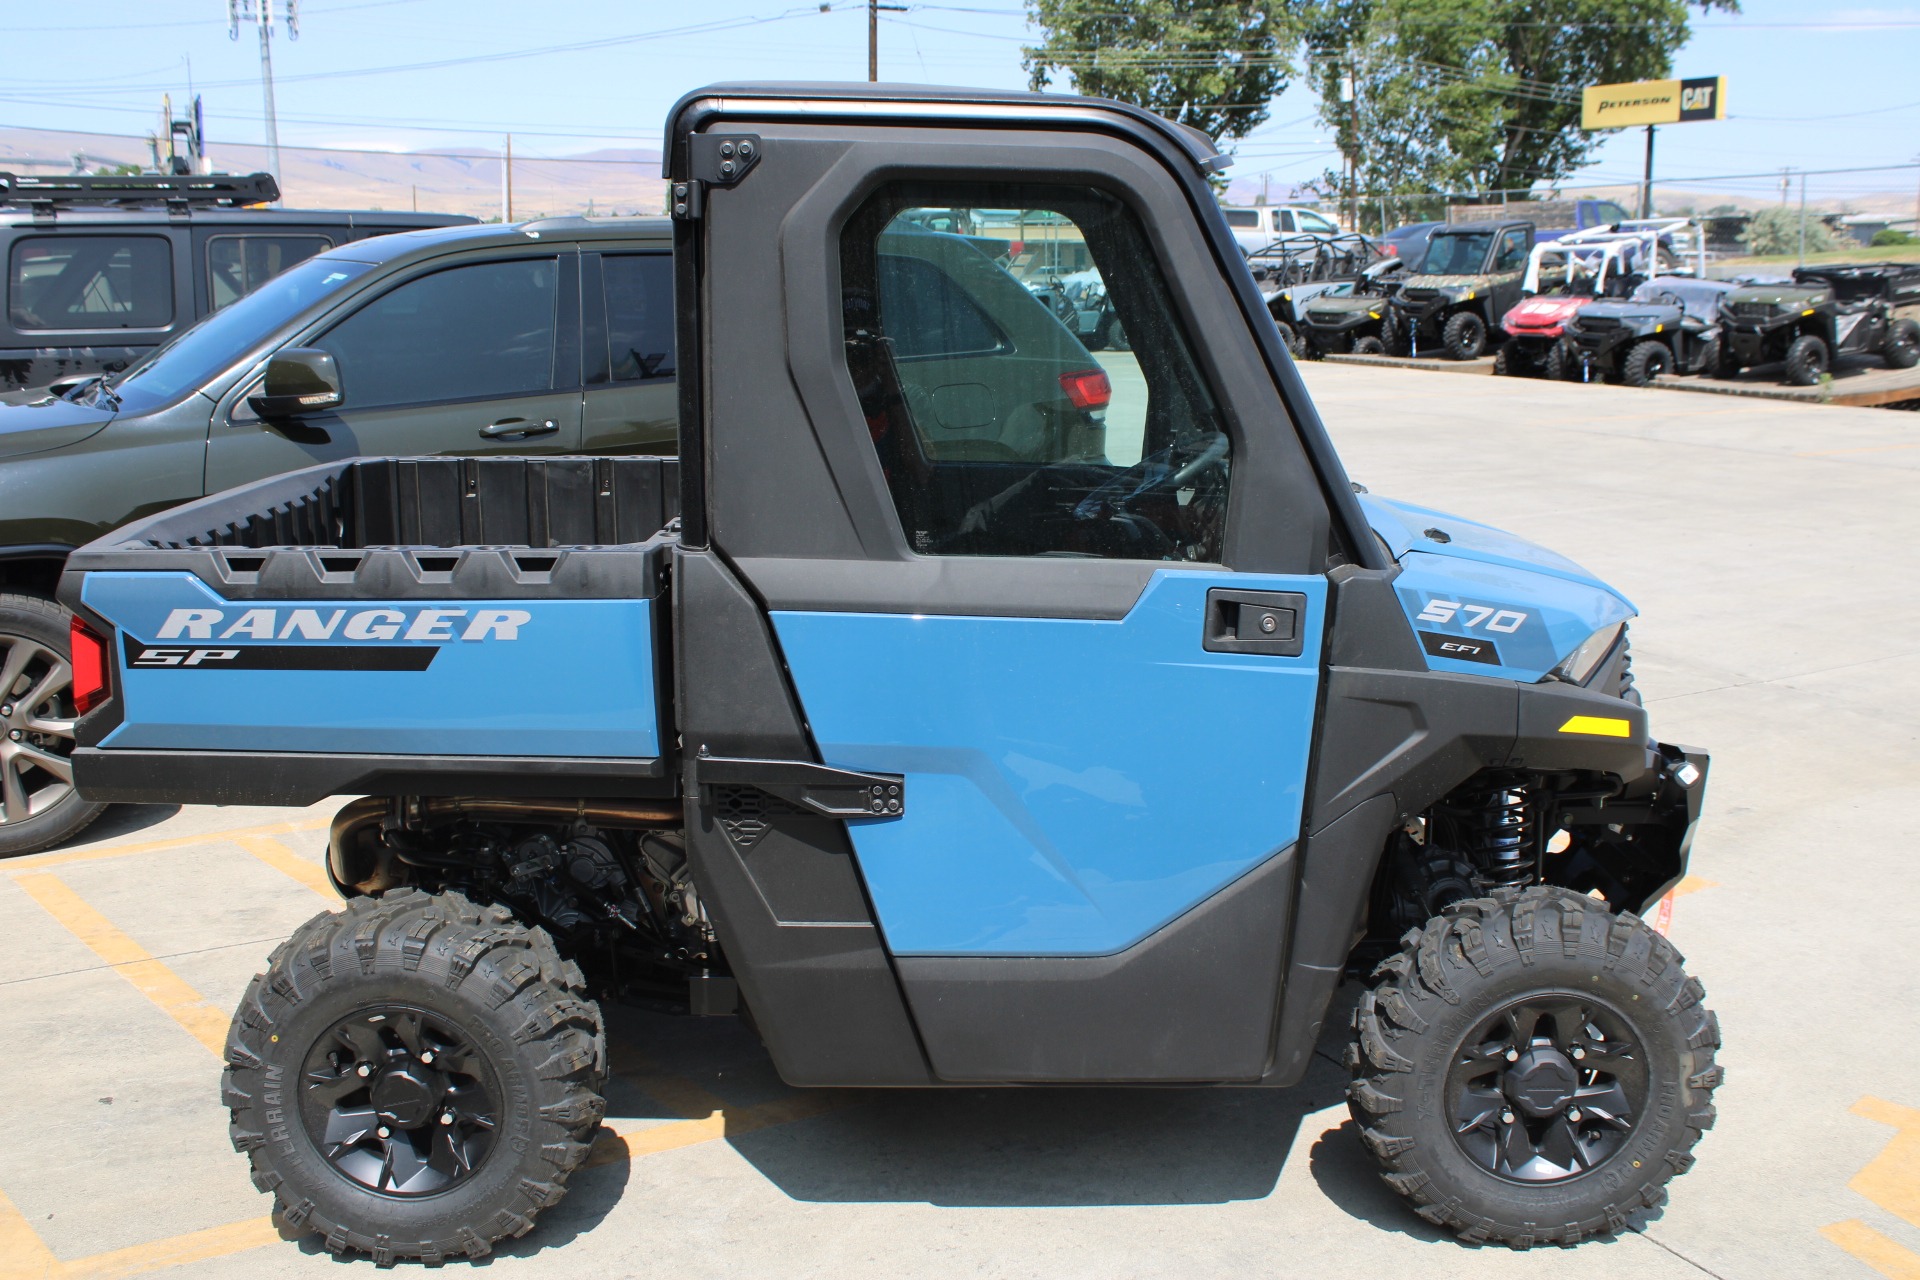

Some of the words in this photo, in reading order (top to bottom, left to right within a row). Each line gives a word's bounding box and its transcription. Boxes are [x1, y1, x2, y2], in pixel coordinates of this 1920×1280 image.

[1597, 95, 1672, 114] PETERSON
[1682, 86, 1714, 111] CAT
[156, 608, 532, 641] RANGER
[1416, 599, 1528, 634] 570
[133, 649, 241, 666] SP
[1440, 642, 1482, 655] EFI
